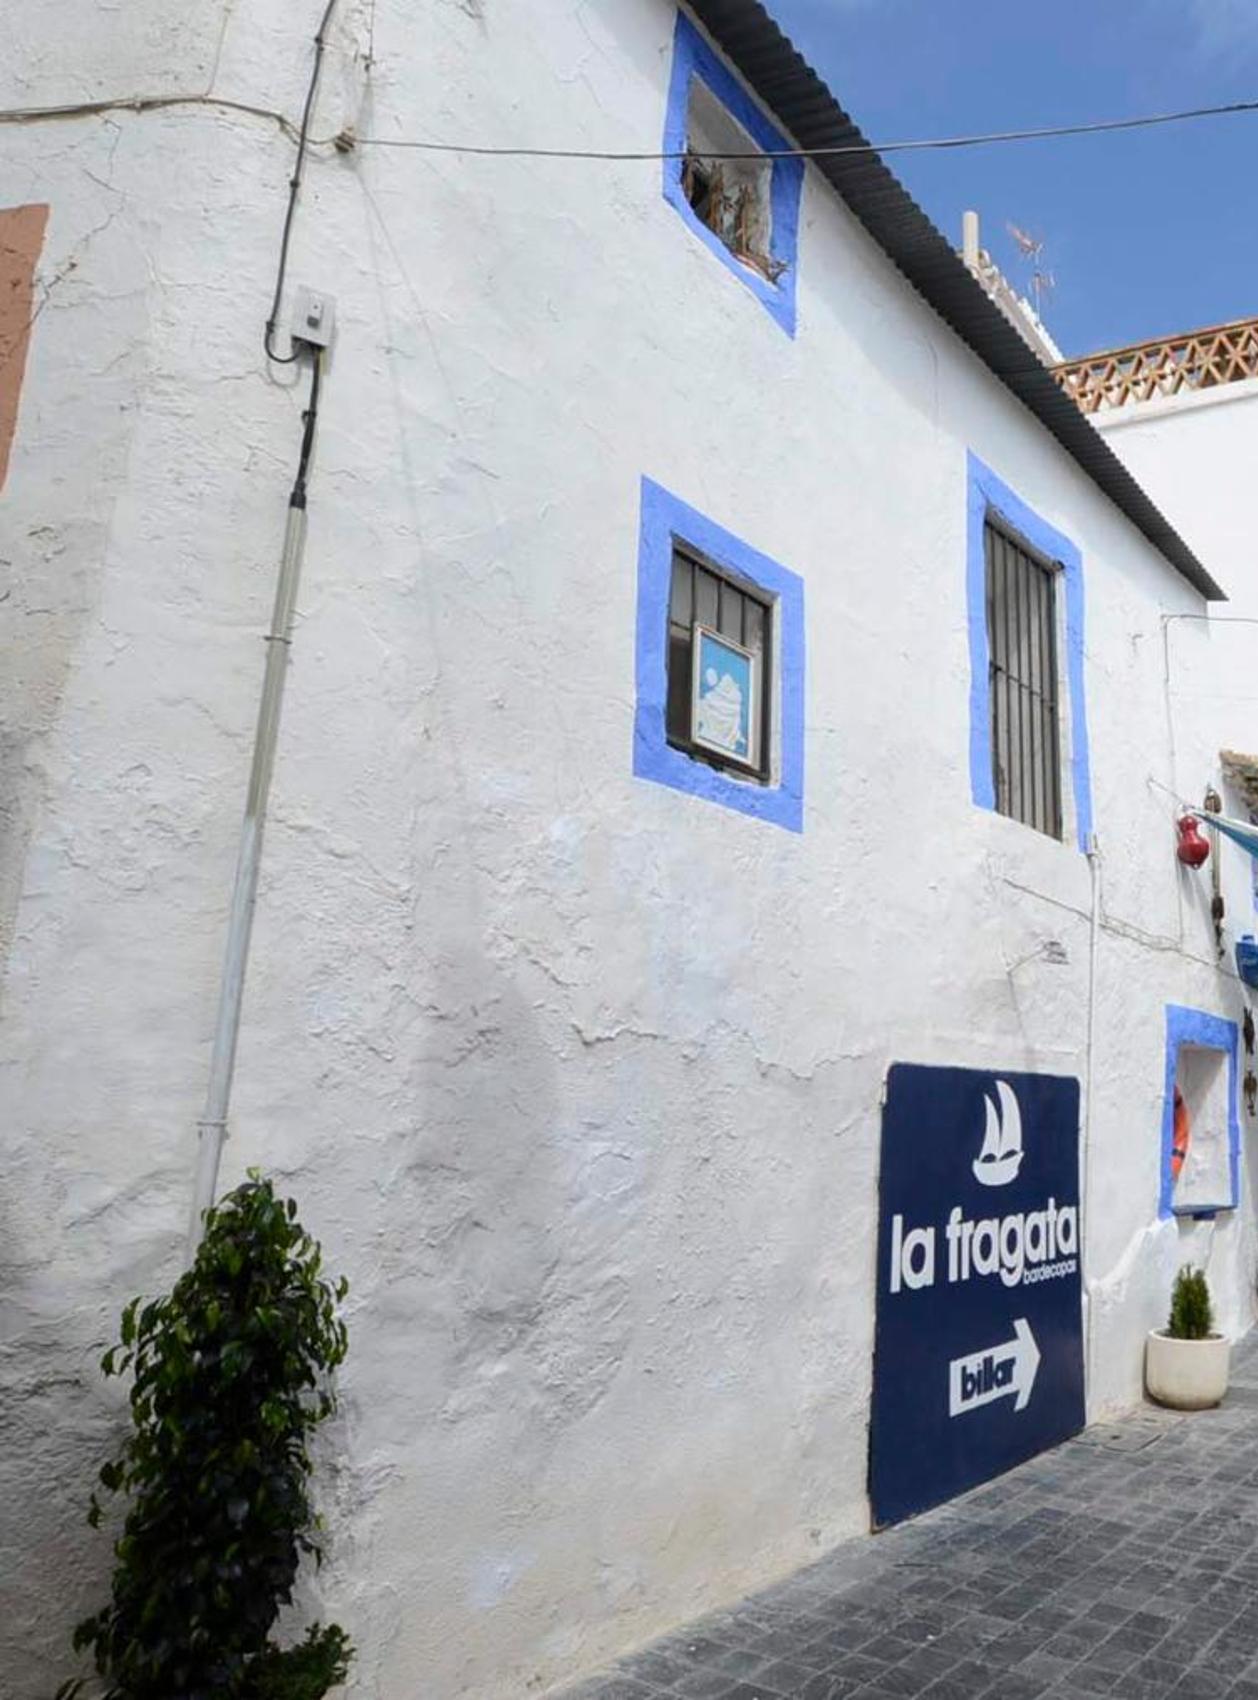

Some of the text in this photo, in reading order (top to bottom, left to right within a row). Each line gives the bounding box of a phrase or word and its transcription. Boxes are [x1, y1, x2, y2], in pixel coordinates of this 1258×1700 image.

[890, 1197, 1077, 1294] la fragata
[961, 1355, 1016, 1403] billar
